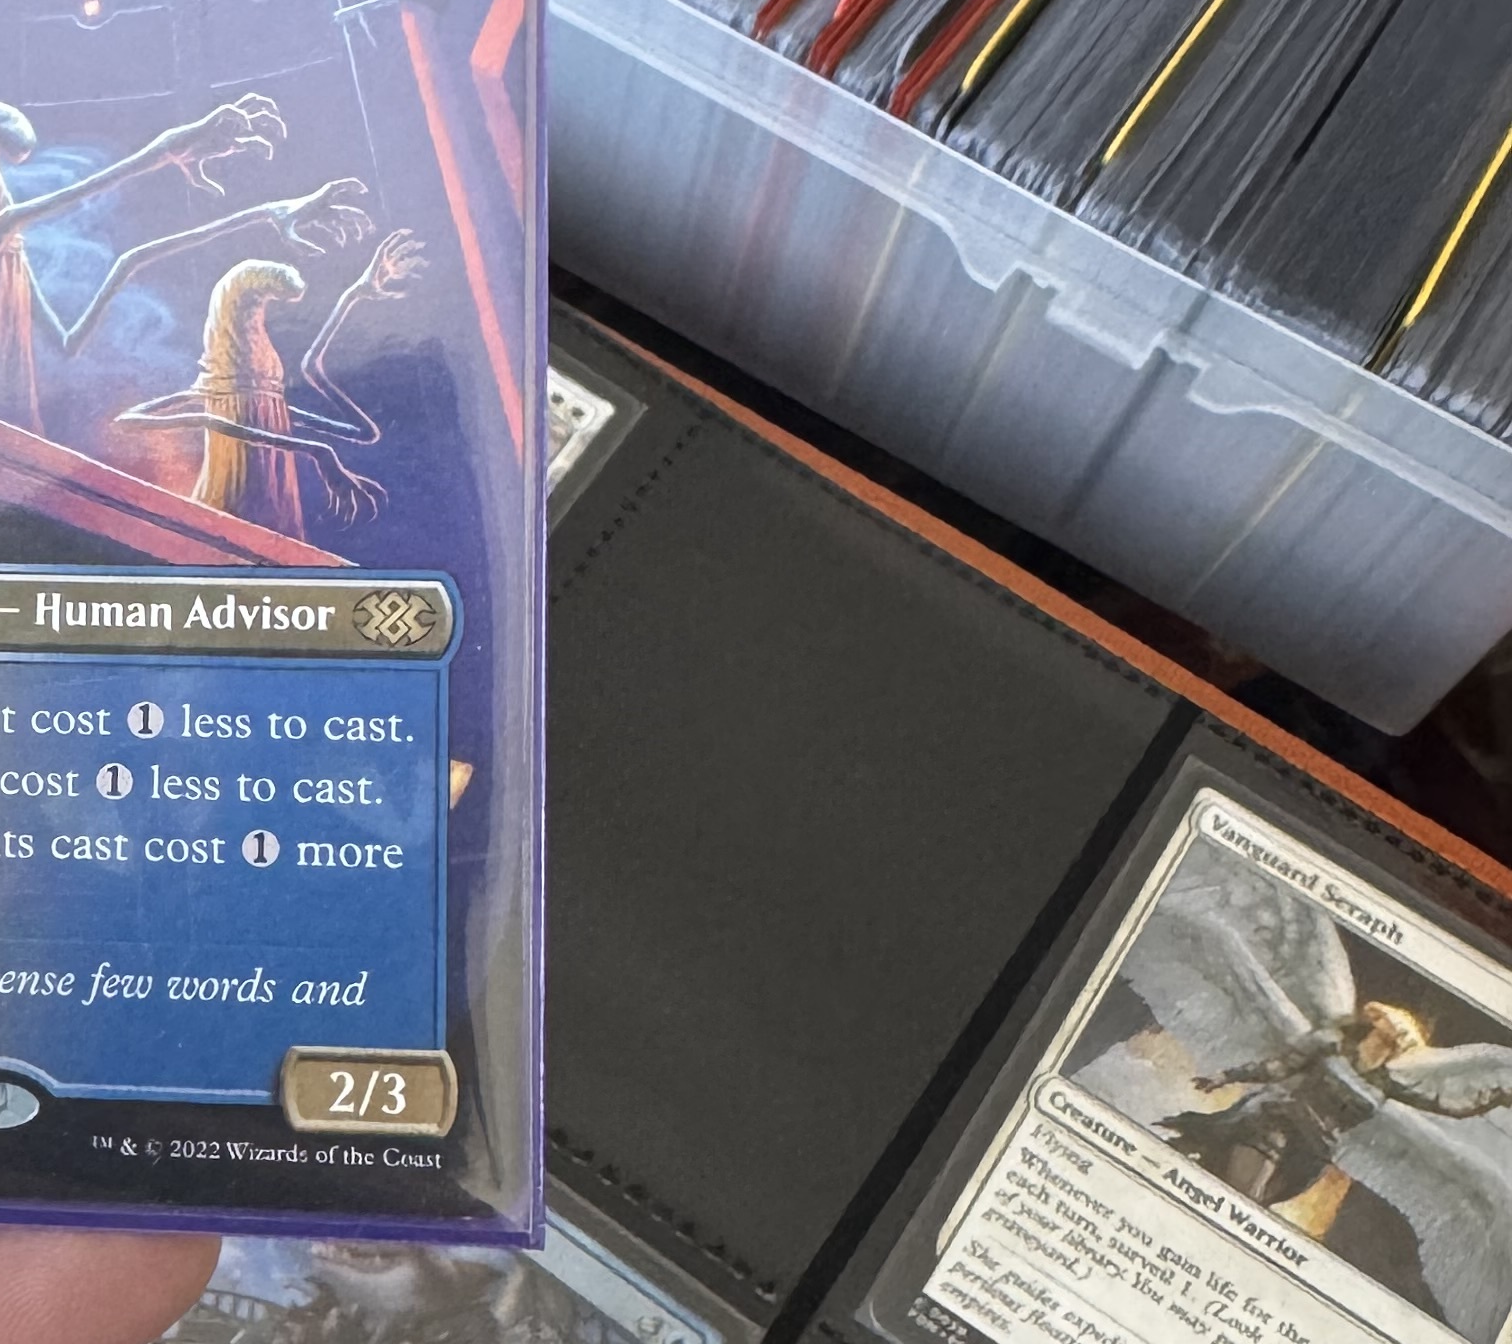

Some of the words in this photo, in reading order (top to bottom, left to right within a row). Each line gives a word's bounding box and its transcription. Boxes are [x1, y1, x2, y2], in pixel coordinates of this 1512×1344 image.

[35, 593, 171, 632] Human
[184, 595, 335, 630] Advisor
[30, 702, 111, 740] cost
[181, 701, 253, 743] less
[269, 706, 307, 744] to
[323, 706, 416, 747] cast.
[0, 765, 81, 801] cost
[149, 763, 222, 805] less
[236, 770, 276, 806] to
[292, 770, 384, 809] cast.
[49, 828, 129, 865] cast
[143, 830, 225, 867] cost
[296, 839, 404, 872] more
[84, 961, 154, 1011] few
[167, 965, 276, 1006] words
[290, 967, 366, 1009] and
[327, 1071, 408, 1117] 2/3
[170, 1139, 221, 1161] 2022
[226, 1141, 308, 1163] Wizards
[315, 1145, 339, 1164] of
[343, 1145, 375, 1166] the
[382, 1148, 442, 1169] Coast
